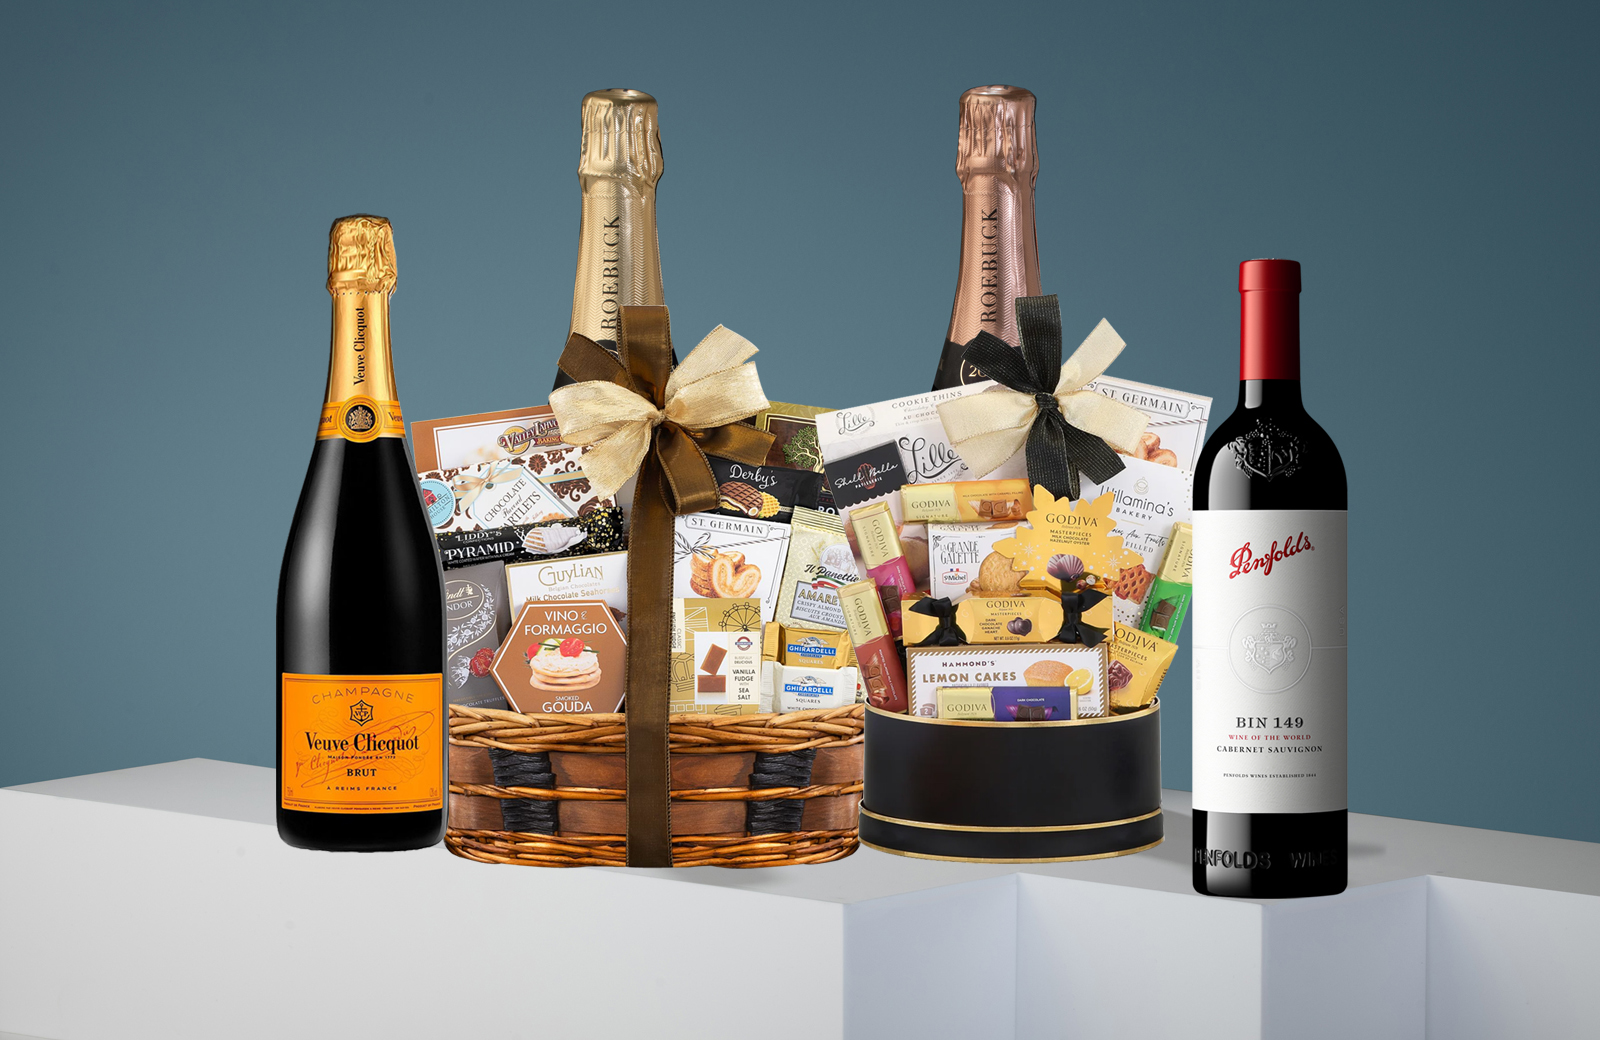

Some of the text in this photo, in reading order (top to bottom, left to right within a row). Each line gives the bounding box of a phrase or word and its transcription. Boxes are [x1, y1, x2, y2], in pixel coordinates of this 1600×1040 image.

[980, 208, 998, 324] ROEBUCK
[601, 216, 620, 331] ROEBUCK
[353, 307, 368, 386] Veuve Clicquot
[891, 396, 930, 410] COOKIE
[932, 390, 963, 402] THINS
[1101, 387, 1184, 414] ST. GERMAIN
[835, 411, 876, 435] Lille
[898, 436, 963, 485] Lille
[729, 464, 778, 490] Derby's
[484, 478, 527, 522] CHOCOLATE
[911, 499, 951, 509] GODIVA
[1045, 512, 1098, 527] GODIVA
[1115, 507, 1153, 521] BAKERY
[690, 517, 764, 535] ST. GERMAIN
[871, 519, 890, 558] GODIVA
[1050, 529, 1092, 538] MASTERPIECES
[444, 541, 515, 561] PYRAMID
[1125, 541, 1154, 553] FILLED
[940, 551, 981, 565] GALETTE
[1229, 531, 1312, 580] Penfolds
[815, 566, 862, 583] Panettie
[548, 581, 601, 592] Belgian Chocolates
[525, 594, 542, 602] Milk
[542, 591, 580, 601] Chocolate
[797, 588, 841, 607] AMARE
[446, 600, 474, 612] NDOR
[795, 606, 821, 615] BISCUITS
[796, 600, 842, 613] CRISPY ALMOND
[986, 600, 1026, 608] GODIVA
[544, 609, 579, 622] VINO
[820, 616, 847, 626] AMANDE
[854, 597, 873, 638] GODIVA
[524, 622, 608, 636] FORMAGGIO
[1115, 628, 1157, 653] ODIVA
[788, 644, 835, 655] GHIRARDELLI
[1110, 643, 1148, 662] ASTERPIECES
[942, 660, 996, 668] HAMMOND'S
[922, 671, 1018, 684] LEMON CAKES
[1152, 668, 1169, 697] TERPIECES
[311, 686, 415, 705] CHAMPAGNE
[785, 685, 833, 694] GHIRARDELLI
[542, 701, 594, 713] GOUDA
[946, 703, 988, 712] GODIVA
[1236, 716, 1305, 729] BIN 149
[305, 731, 419, 755] Veuve Clicquot
[1216, 745, 1324, 754] CABERNET SAUVIGNON
[346, 768, 378, 777] BRUT
